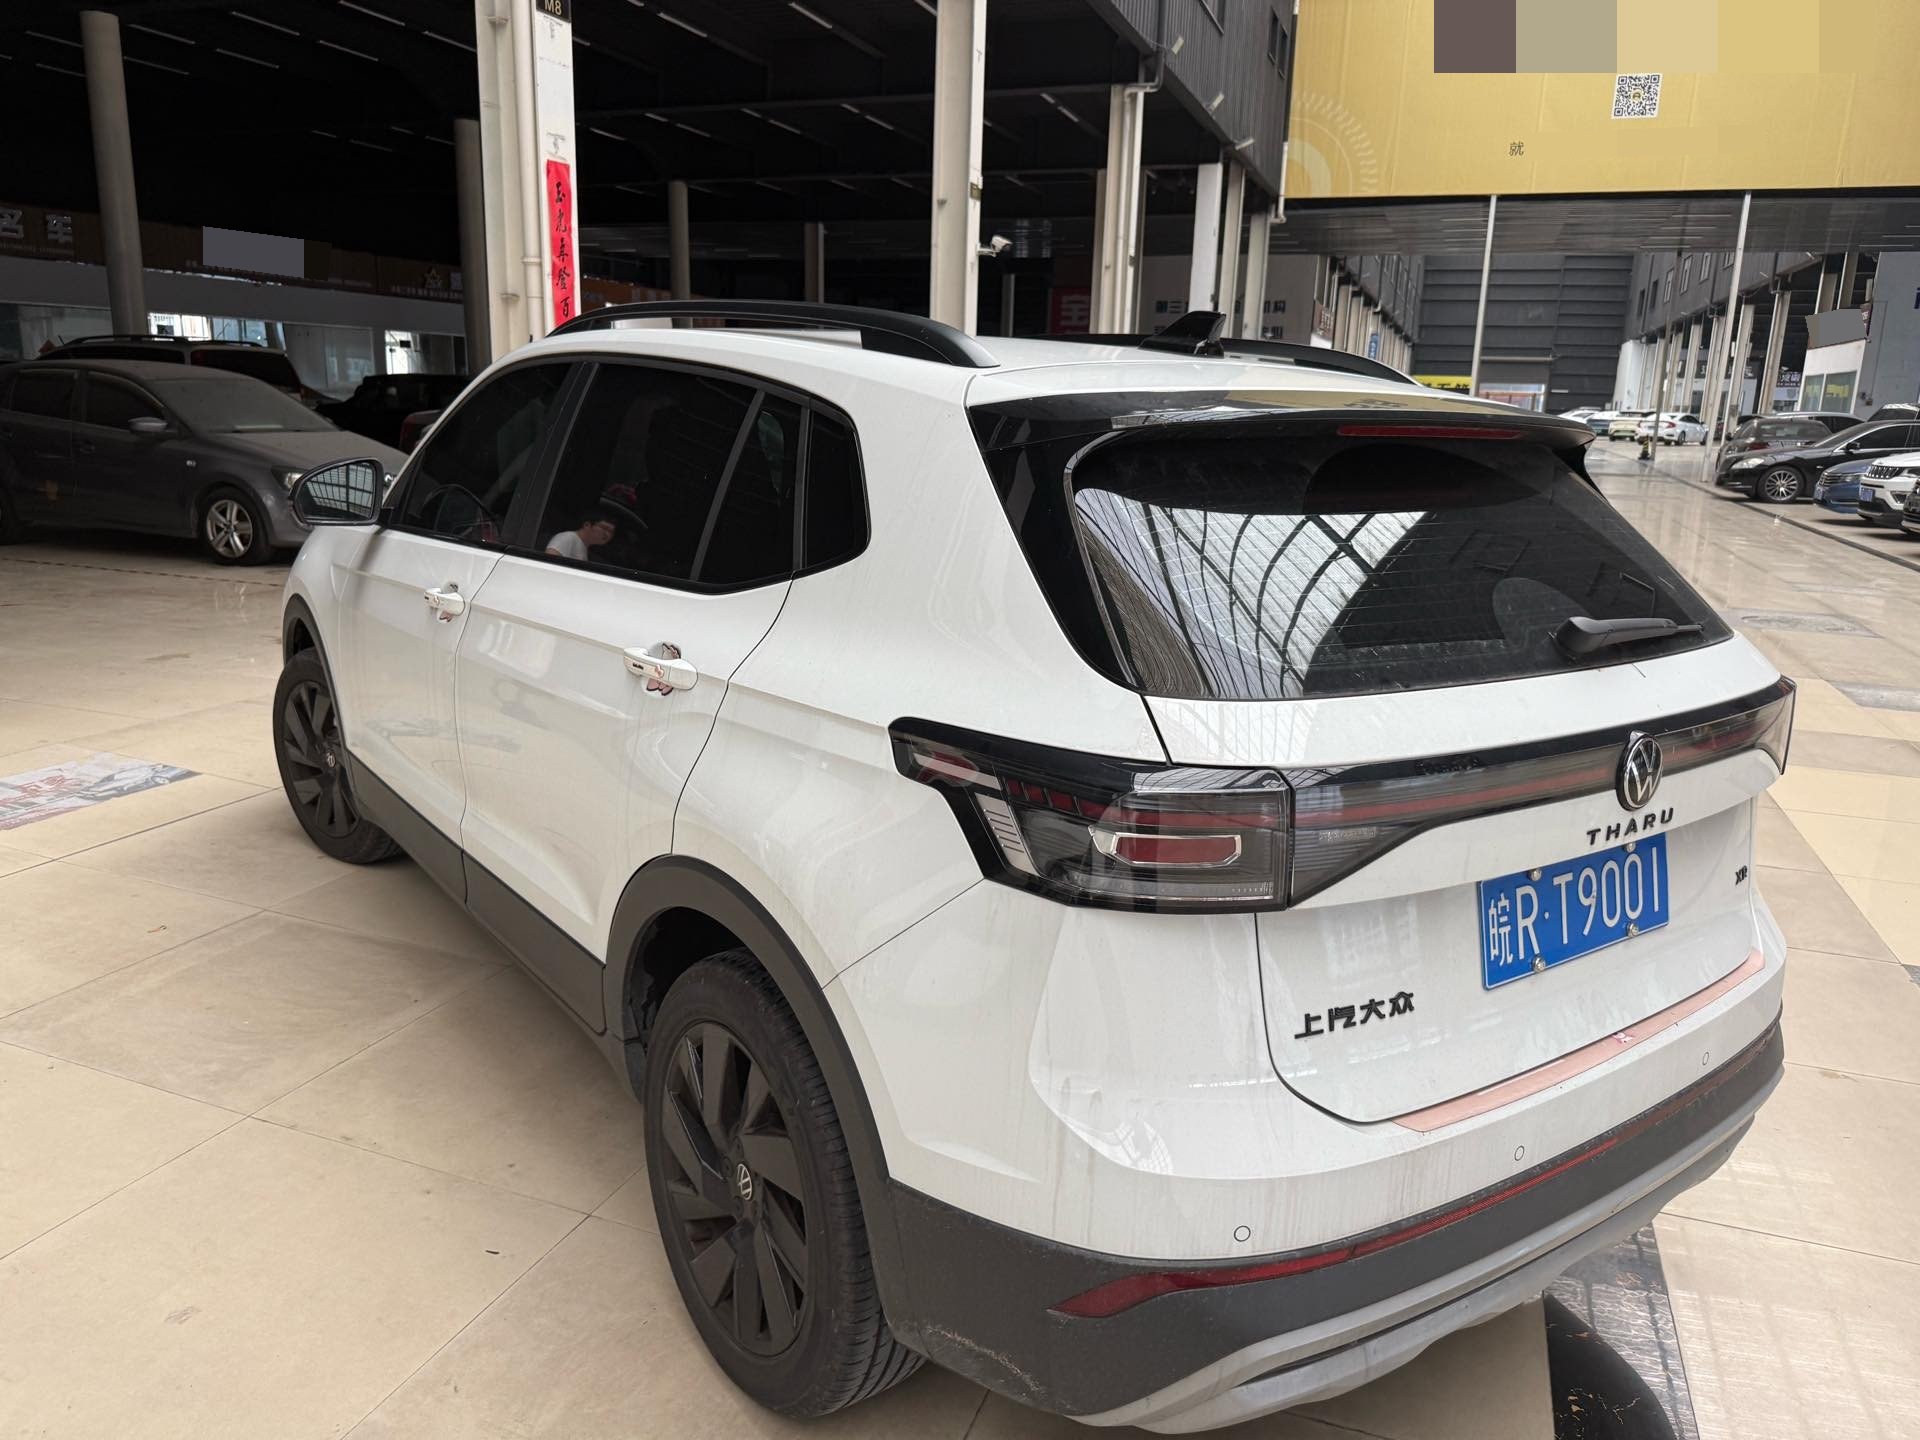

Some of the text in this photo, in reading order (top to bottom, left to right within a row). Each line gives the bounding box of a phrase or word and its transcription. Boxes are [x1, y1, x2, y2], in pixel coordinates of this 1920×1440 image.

[1509, 141, 1524, 156] 就
[1587, 807, 1674, 846] THARU
[1294, 991, 1415, 1039] 上汽大众
